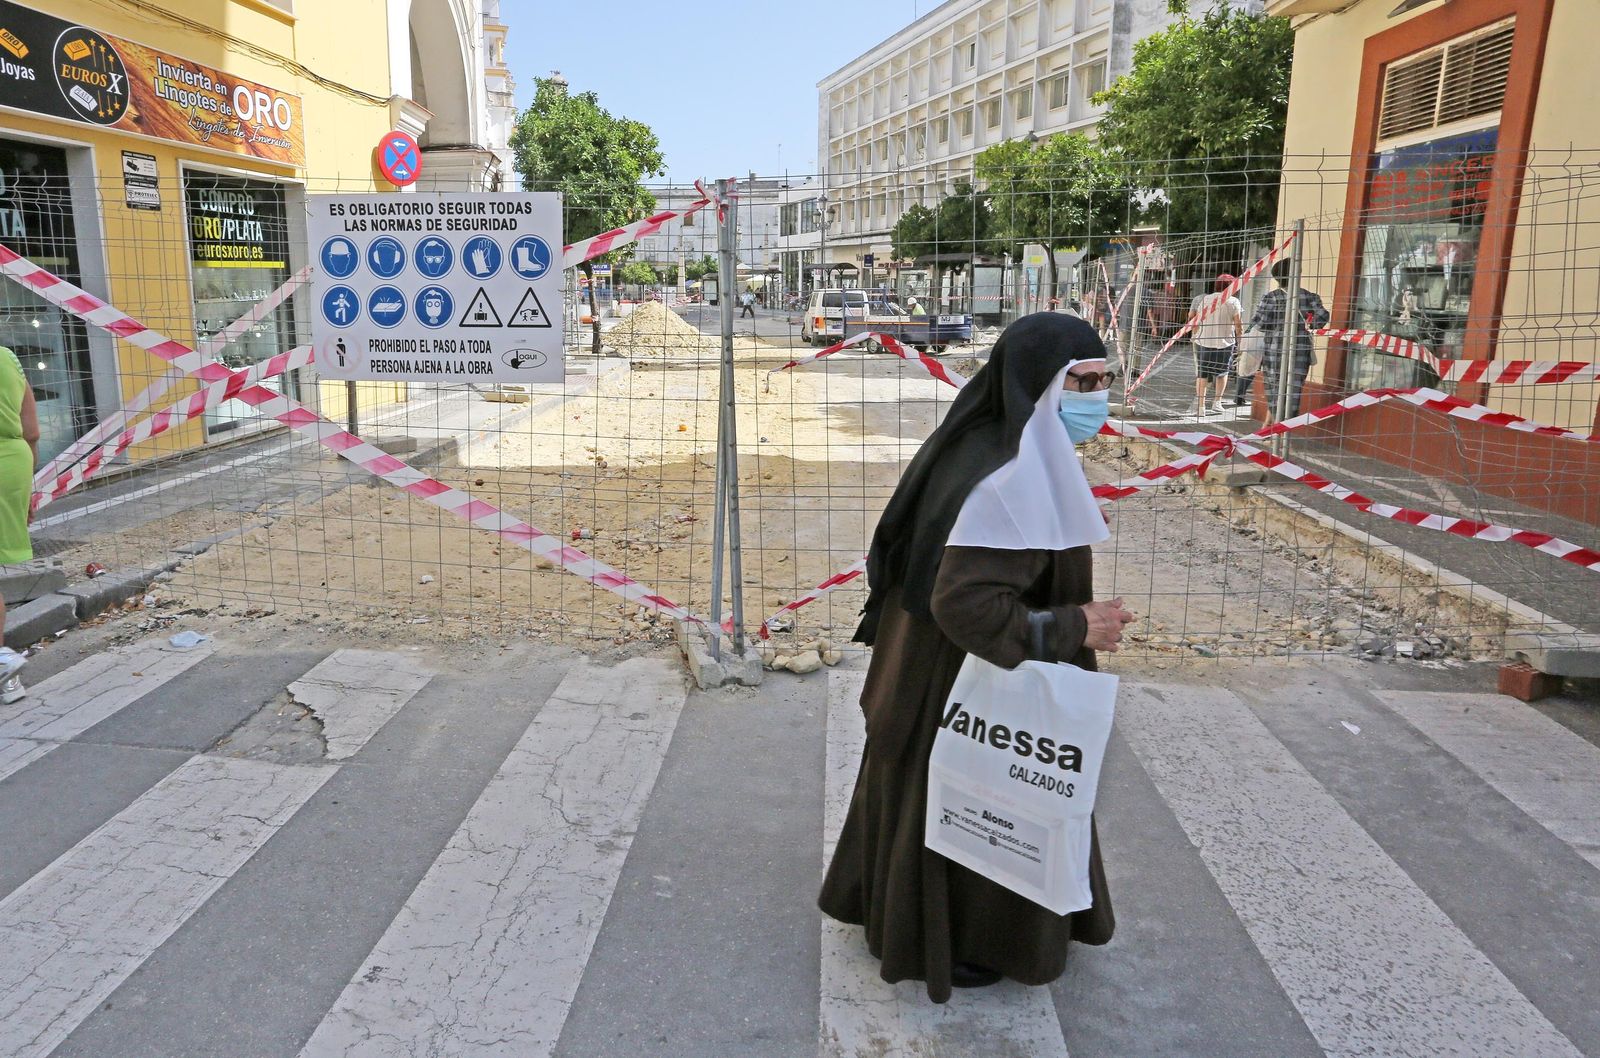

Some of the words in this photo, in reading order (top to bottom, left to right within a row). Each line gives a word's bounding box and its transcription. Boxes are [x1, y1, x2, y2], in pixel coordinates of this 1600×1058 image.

[2, 32, 20, 46] ORO
[1, 57, 36, 81] Joyas
[157, 57, 212, 91] Invierta
[214, 83, 228, 96] en
[74, 87, 91, 103] PLATA
[154, 77, 217, 111] Lingotes
[220, 102, 232, 116] de
[233, 85, 292, 131] ORO
[188, 108, 229, 142] Lingotes
[233, 122, 246, 138] de
[199, 190, 255, 216] COMPRO
[329, 203, 345, 216] ES
[350, 202, 434, 216] OBLIGATORIO
[438, 202, 486, 215] SEGUIR
[489, 201, 532, 215] TODAS
[194, 216, 264, 241] ORO/PLATA
[344, 219, 367, 232] LAS
[371, 218, 422, 232] NORMAS
[426, 218, 442, 231] DE
[446, 218, 518, 231] SEGURIDAD
[197, 244, 264, 259] eurosxoro.es
[369, 339, 417, 353] PROHIBIDO
[420, 339, 431, 353] EL
[433, 339, 457, 354] PASO
[460, 340, 466, 354] A
[467, 340, 492, 354] TODA
[370, 359, 412, 373] PERSONA
[414, 360, 443, 374] AJENA
[445, 360, 452, 374] A
[453, 360, 466, 374] LA
[468, 361, 494, 375] OBRA
[939, 702, 1083, 774] Vanessa
[1009, 763, 1075, 798] CALZADOS
[981, 809, 1014, 830] Alonso
